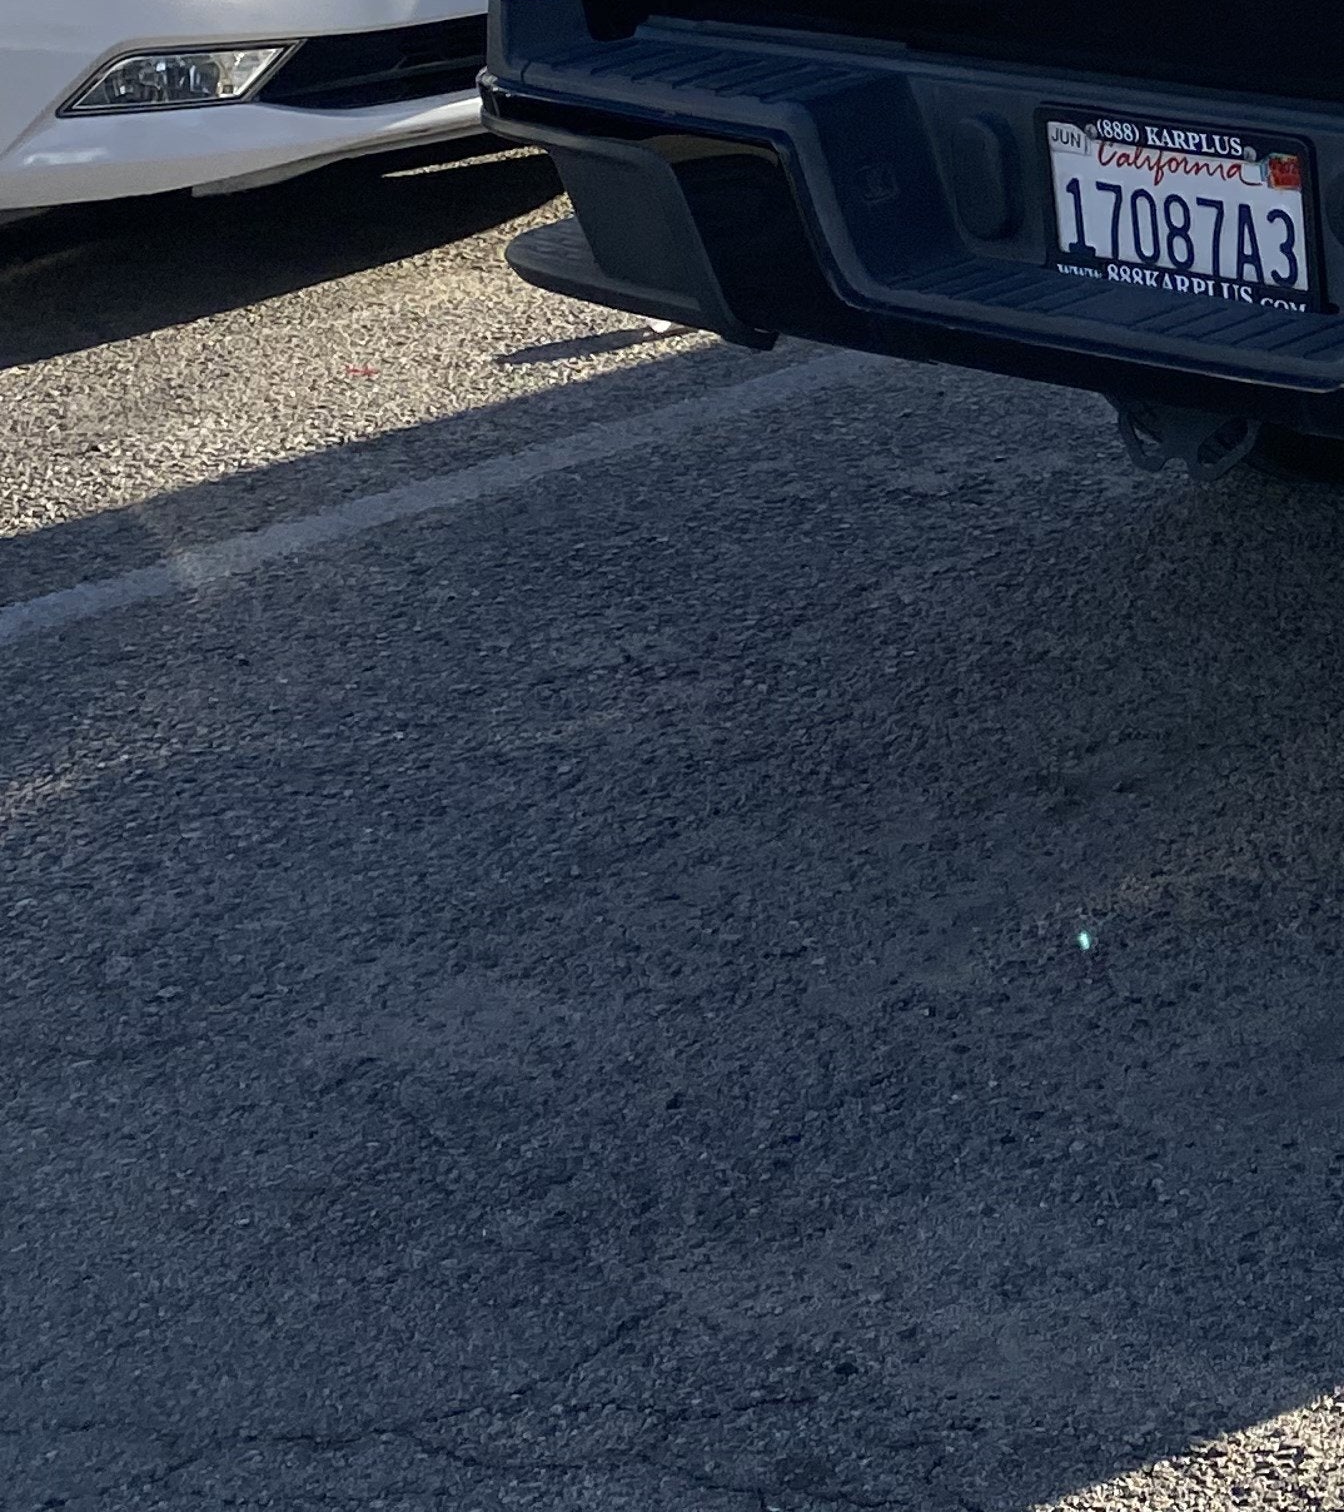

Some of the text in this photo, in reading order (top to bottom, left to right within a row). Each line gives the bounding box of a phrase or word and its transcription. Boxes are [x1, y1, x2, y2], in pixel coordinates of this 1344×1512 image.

[1051, 127, 1082, 150] JUN
[1096, 119, 1243, 157] (888) KARPLUS
[1096, 143, 1262, 187] California
[1066, 177, 1299, 289] 17087A3
